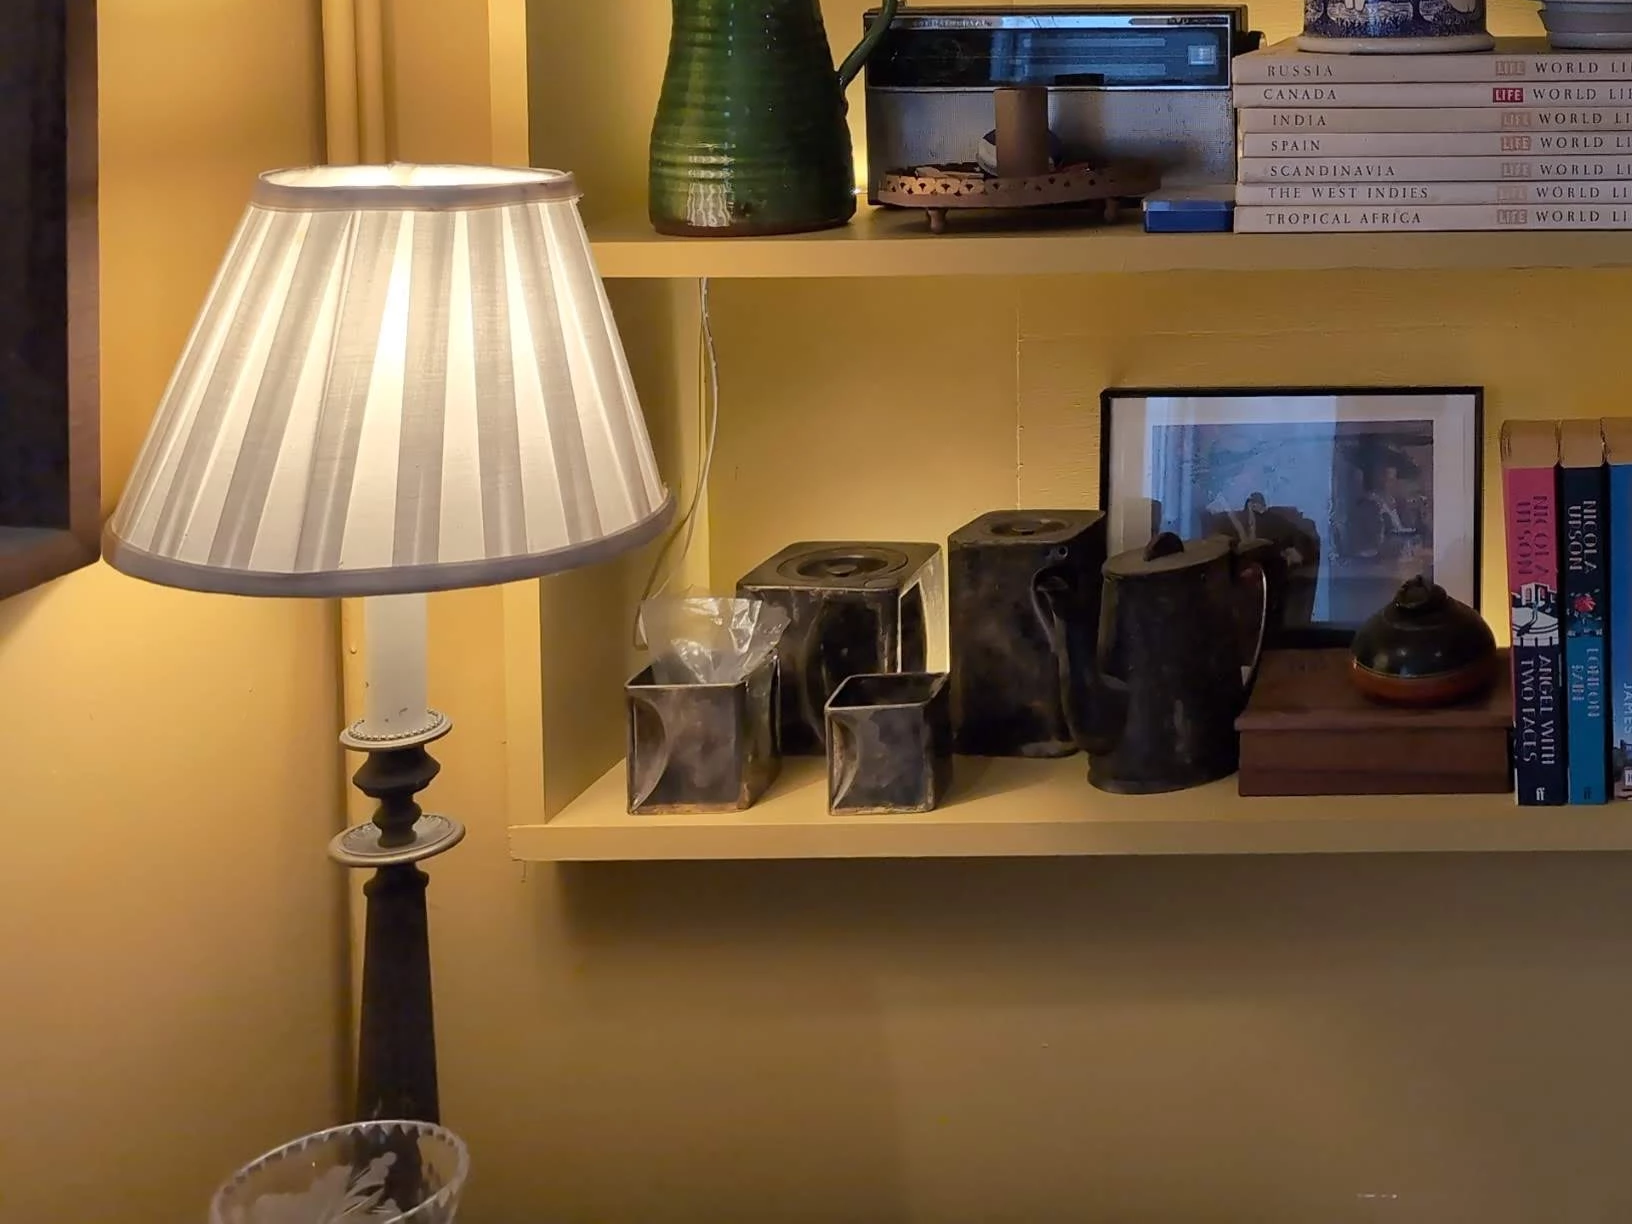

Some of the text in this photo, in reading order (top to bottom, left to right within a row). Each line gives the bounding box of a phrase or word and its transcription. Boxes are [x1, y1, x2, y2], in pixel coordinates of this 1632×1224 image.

[1267, 64, 1334, 77] RUSSIA
[1535, 61, 1599, 74] WORLD
[1263, 88, 1337, 100] CANADA
[1495, 89, 1522, 101] LIFE
[1533, 88, 1597, 100] WORLD
[1272, 114, 1327, 126] INDIA
[1538, 112, 1602, 125] WORLD
[1271, 140, 1321, 152] SPAIN
[1503, 137, 1529, 150] LIFE
[1540, 136, 1604, 149] WORLD
[1270, 165, 1395, 177] SCANDINAVIA
[1540, 163, 1604, 176] WORLD
[1268, 187, 1301, 199] THE
[1312, 187, 1358, 199] WEST
[1367, 187, 1429, 199] INDIES
[1536, 187, 1600, 199] WORLD
[1266, 213, 1351, 225] TROPICAL
[1360, 212, 1422, 224] AFRICA
[1536, 210, 1600, 223] WORLD
[1568, 505, 1583, 571] UPSON
[1583, 500, 1598, 574] NICOLA
[1521, 660, 1537, 763] TWO FACES
[1539, 654, 1555, 765] ANGEL WITH
